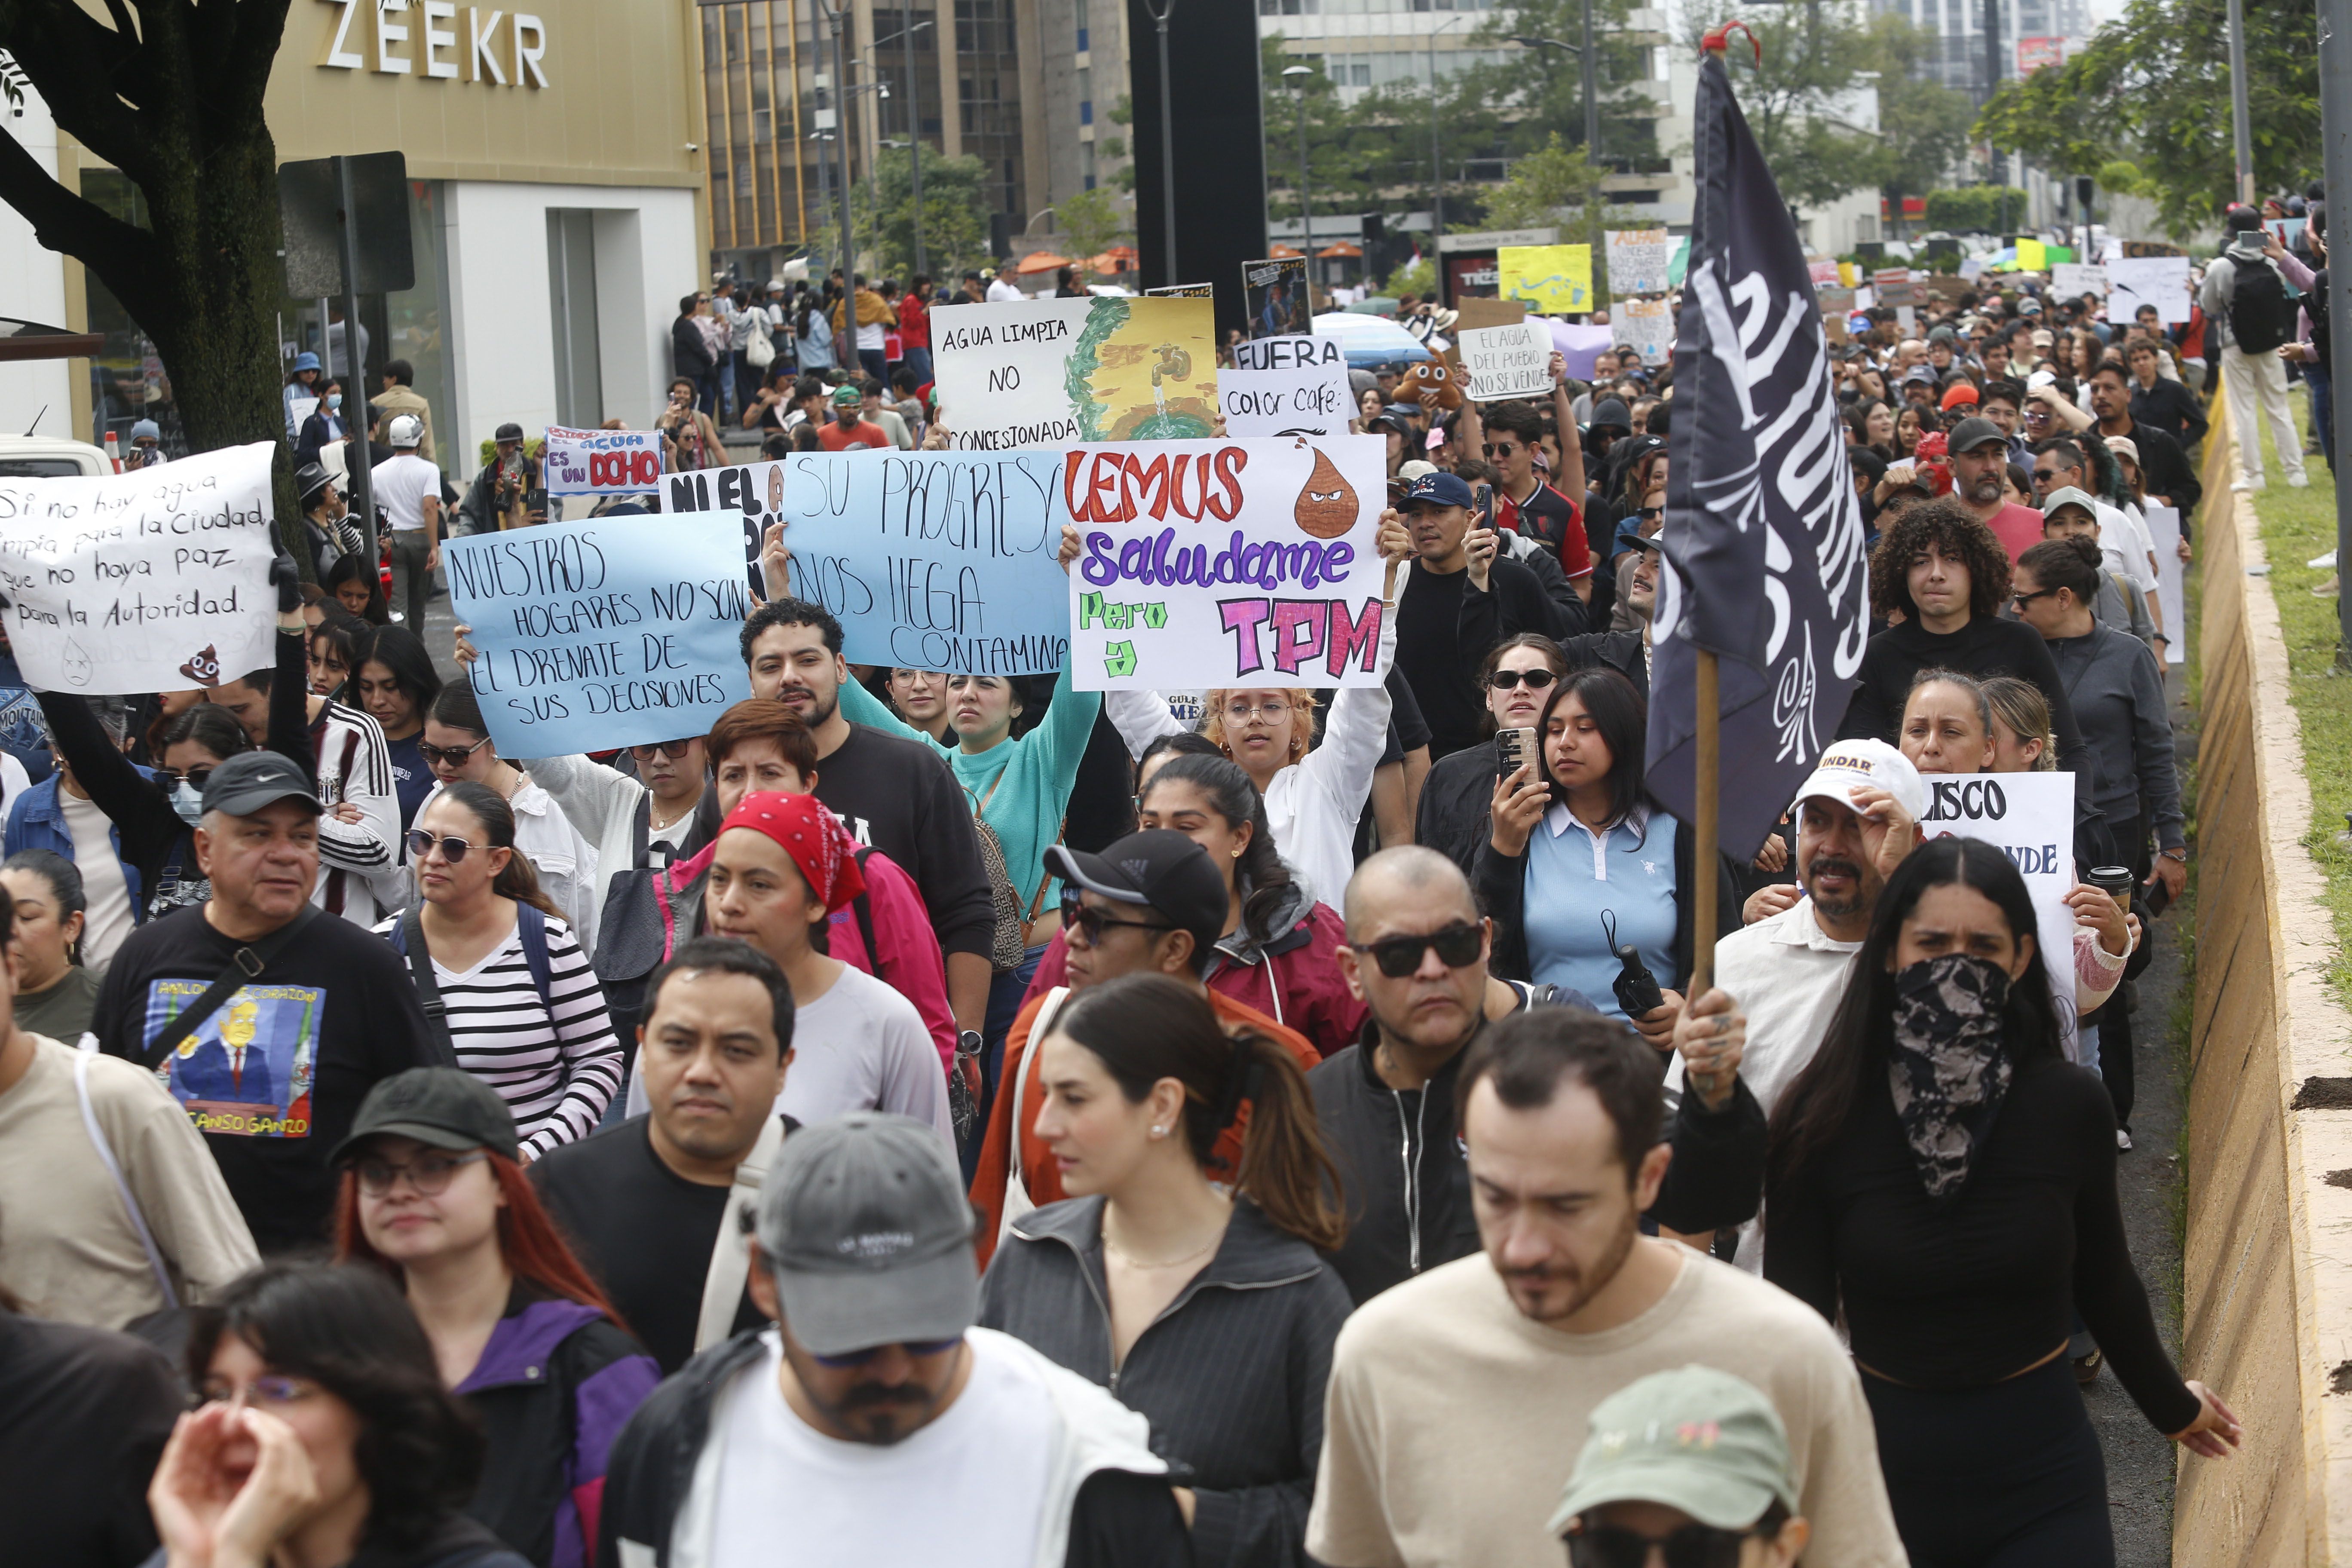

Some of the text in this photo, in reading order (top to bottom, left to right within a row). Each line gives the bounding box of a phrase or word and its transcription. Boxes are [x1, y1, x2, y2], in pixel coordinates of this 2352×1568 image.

[316, 0, 549, 88] ZEEKR
[942, 319, 1068, 352] AGUA LIMPIA
[1237, 339, 1340, 370] FUERA
[1480, 328, 1532, 348] EL AGUA
[989, 365, 1020, 393] NO
[1473, 349, 1540, 370] DEL PUEBLO
[1497, 371, 1511, 392] SE
[580, 435, 644, 450] AGUA
[950, 418, 1080, 451] CONCESIONADA
[549, 451, 570, 466] ES
[561, 467, 586, 483] UN
[0, 475, 217, 519] Si no hay agua
[671, 474, 710, 513] NI
[718, 467, 763, 516] EL
[797, 457, 850, 517] SU
[1064, 446, 1248, 524] LEMUS
[74, 526, 122, 554] para
[141, 514, 163, 535] la
[1, 569, 36, 600] que
[48, 566, 75, 585] no
[95, 550, 152, 588] haya
[450, 531, 606, 600] NUESTROS
[1081, 527, 1355, 590] Saludame
[789, 553, 874, 616] NOS
[18, 585, 245, 630] para la Autoridad.
[513, 593, 642, 638] HOGARES
[651, 582, 695, 622] NO
[699, 579, 747, 622] SON
[1079, 591, 1169, 630] Pero
[1216, 595, 1384, 680] TPM
[469, 650, 503, 696] EL
[641, 633, 688, 674] DE
[508, 673, 726, 725] SUS DECISIONES
[1169, 695, 1198, 704] GULF
[1994, 844, 2058, 874] NDE
[252, 987, 318, 1004] CORAZON
[246, 1118, 308, 1134] GANZO
